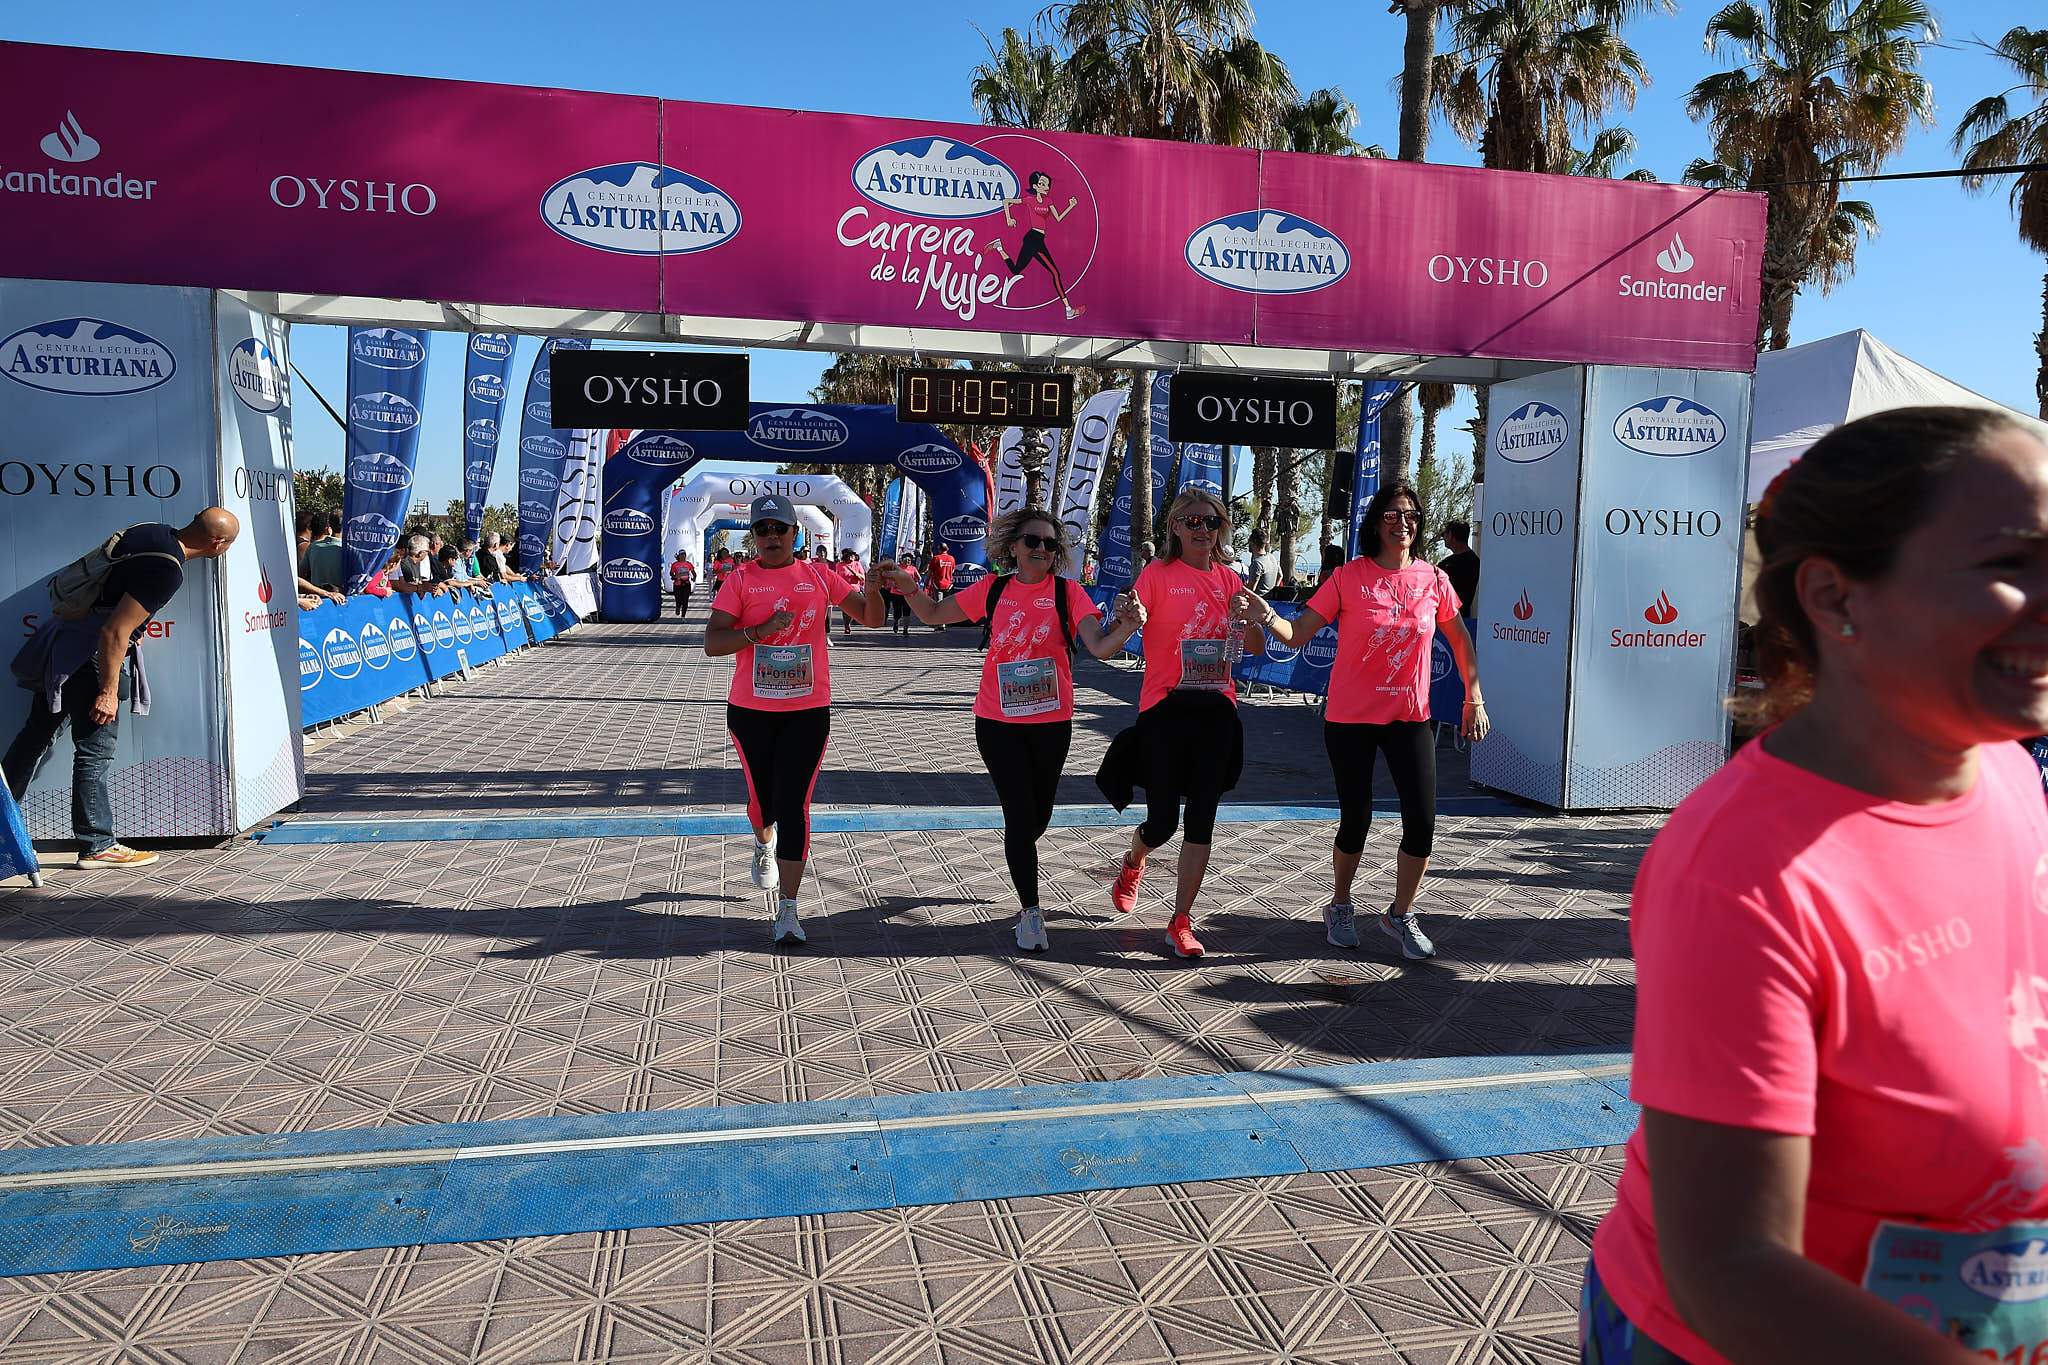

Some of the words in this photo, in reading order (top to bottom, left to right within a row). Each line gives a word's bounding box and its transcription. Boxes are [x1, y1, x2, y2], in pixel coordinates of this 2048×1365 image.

[0, 166, 157, 200] antander
[865, 161, 1006, 201] ASTURIANA
[891, 161, 945, 174] CENTRAL
[949, 166, 1003, 178] LECHERA
[270, 175, 437, 217] OYSHO
[588, 190, 651, 204] CENTRAL
[556, 191, 726, 235] ASTURIANA
[836, 206, 975, 256] Carrera
[1224, 235, 1276, 248] CENTRAL
[1281, 240, 1333, 251] LECHERA
[870, 253, 897, 282] de
[901, 253, 920, 284] la
[1197, 236, 1337, 275] ASTURIANA
[1428, 254, 1549, 289] OYSHO
[915, 253, 1024, 321] Mujer
[1618, 274, 1727, 303] Santander
[8, 343, 164, 379] ASTURIANA
[35, 342, 95, 353] CENTRAL
[99, 345, 157, 356] LECHERA
[583, 374, 722, 410] OYSHO
[910, 377, 1060, 417] 01:05:19
[1197, 395, 1314, 427] OYSHO
[1639, 416, 1674, 425] CENTRAL
[753, 420, 841, 442] ASTURIANA
[1500, 428, 1562, 451] ASTURIANA
[1621, 416, 1717, 443] ASTURIANA
[632, 445, 690, 460] ASTURIANA
[903, 455, 959, 467] ASTURIANA
[0, 462, 182, 499] OYSHO
[234, 466, 288, 503] OYSHO
[557, 437, 588, 545] OYSH
[729, 479, 811, 498] OYSHO
[606, 518, 651, 531] ASTURIANA
[942, 524, 986, 536] ASTURIANA
[1493, 511, 1563, 537] OYSHO
[1606, 509, 1721, 537] OYSHO
[604, 567, 650, 580] ASTURIANA
[244, 609, 288, 634] Santander
[1492, 622, 1551, 645] Santander
[1610, 629, 1706, 648] Santander
[1864, 915, 1973, 983] OYSHO
